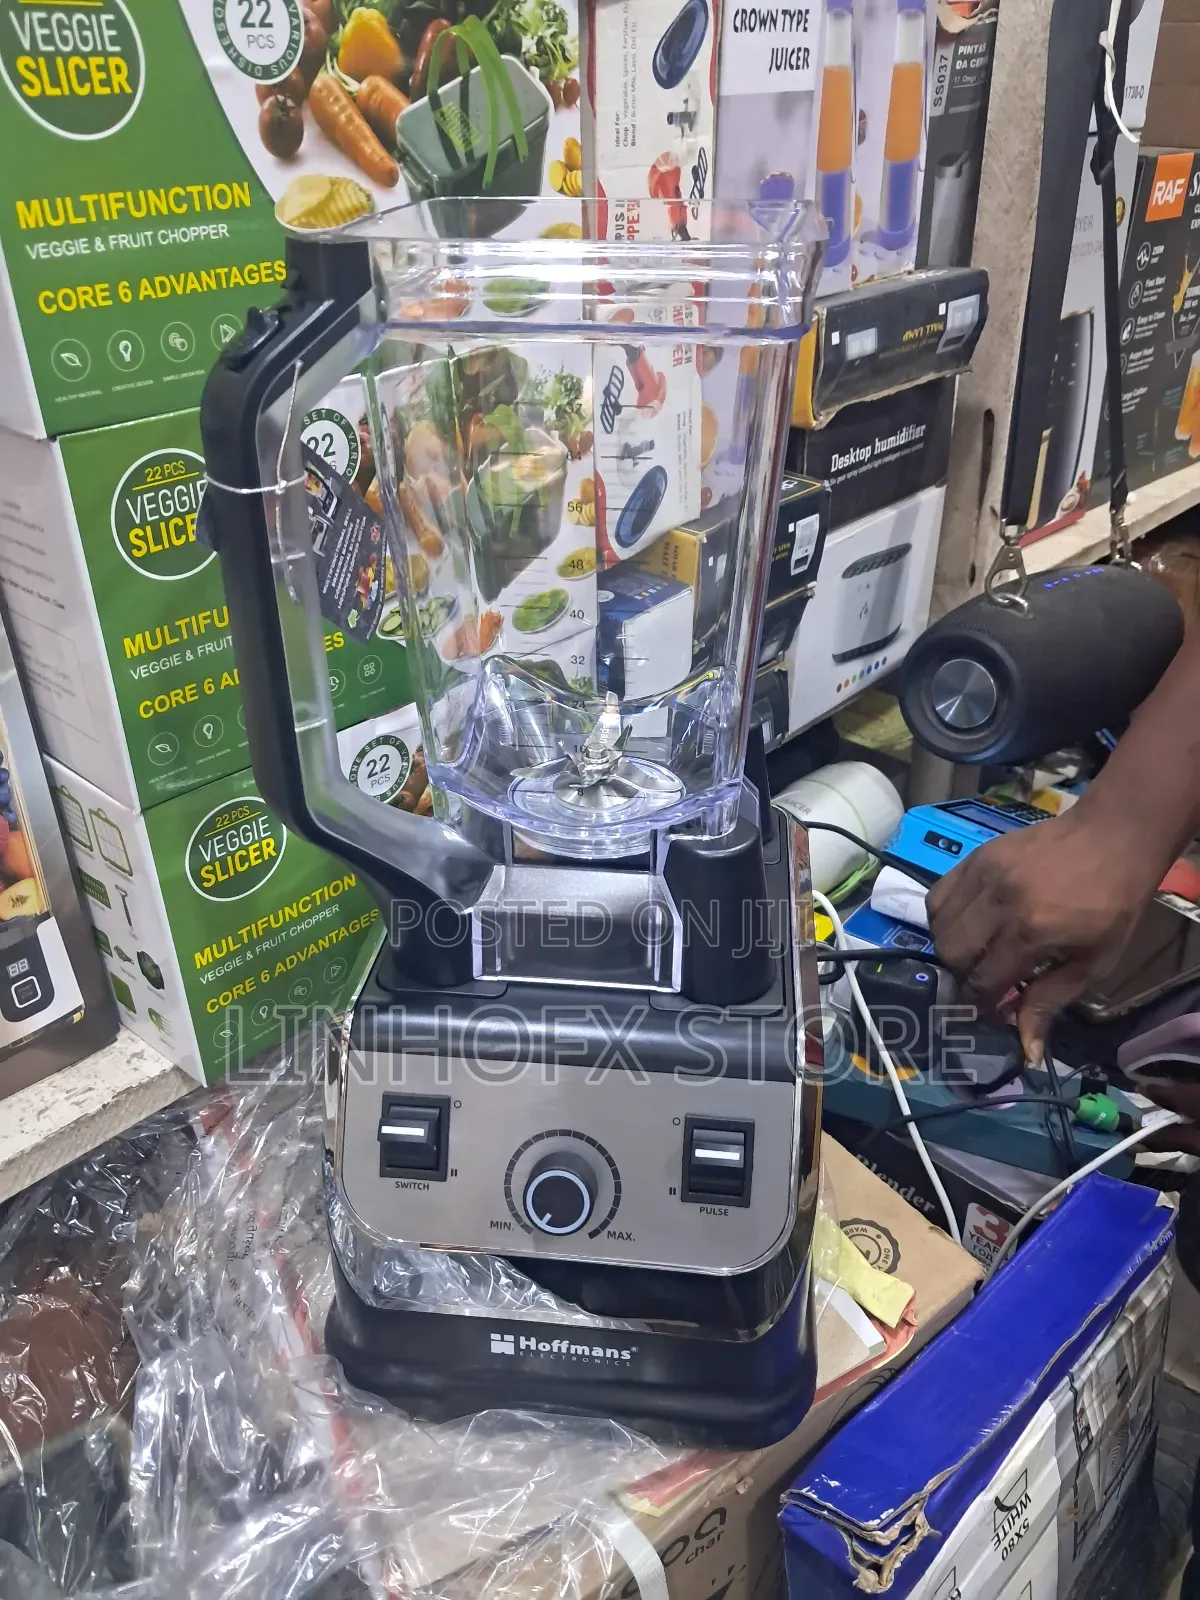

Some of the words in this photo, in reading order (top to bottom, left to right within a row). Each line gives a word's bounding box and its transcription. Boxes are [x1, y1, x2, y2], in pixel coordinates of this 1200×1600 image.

[9, 11, 122, 51] VEGGIE
[733, 9, 778, 33] CROWN
[778, 8, 811, 33] TYPE
[246, 34, 276, 49] PCS
[768, 47, 811, 74] JUICER
[956, 60, 968, 70] DA
[16, 56, 133, 97] SLICER
[933, 54, 949, 107] SS037
[16, 181, 252, 230] MULTIFUNCTION
[1152, 178, 1186, 206] RAF
[26, 237, 91, 260] VEGGIE
[94, 236, 106, 252] &
[109, 231, 155, 250] FRUIT
[157, 224, 230, 245] CHOPPER
[38, 281, 113, 314] CORE
[118, 280, 133, 303] 6
[138, 259, 287, 301] ADVANTAGES
[303, 409, 328, 426] SET
[333, 412, 349, 427] OF
[831, 445, 872, 473] Desktop
[873, 423, 927, 455] humidifier
[145, 467, 164, 483] 22
[164, 460, 186, 477] PCS
[567, 502, 583, 512] 56
[568, 559, 584, 570] 48
[569, 609, 585, 620] 40
[130, 653, 182, 680] VEGGIE
[185, 650, 194, 661] &
[570, 655, 586, 666] 32
[139, 683, 200, 719] CORE
[203, 677, 215, 696] 6
[364, 736, 384, 752] SET
[389, 738, 402, 747] OF
[366, 753, 391, 779] 22
[370, 773, 391, 789] PCS
[215, 814, 231, 829] 22
[231, 805, 250, 823] PCS
[199, 816, 272, 863] VEGGIE
[200, 838, 277, 888] SLICER
[194, 872, 358, 970] MULTIFUNCTION
[199, 957, 244, 985] VEGGIE
[245, 950, 254, 961] &
[256, 932, 288, 956] FRUIT
[289, 904, 341, 937] CHOPPER
[206, 976, 257, 1014] CORE
[260, 969, 271, 983] 6
[274, 908, 380, 978] ADVANTAGES
[395, 1180, 430, 1191] SWITCH
[699, 1206, 730, 1217] PULSE
[489, 1220, 515, 1232] MIN.
[606, 1229, 637, 1242] MAX.
[973, 1206, 1012, 1247] 3
[883, 1247, 891, 1265] ONE
[519, 1350, 631, 1367] ELECTRONICS
[991, 1492, 1032, 1553] WHITE
[684, 1530, 725, 1565] char
[1001, 1517, 1030, 1562] 5X80
